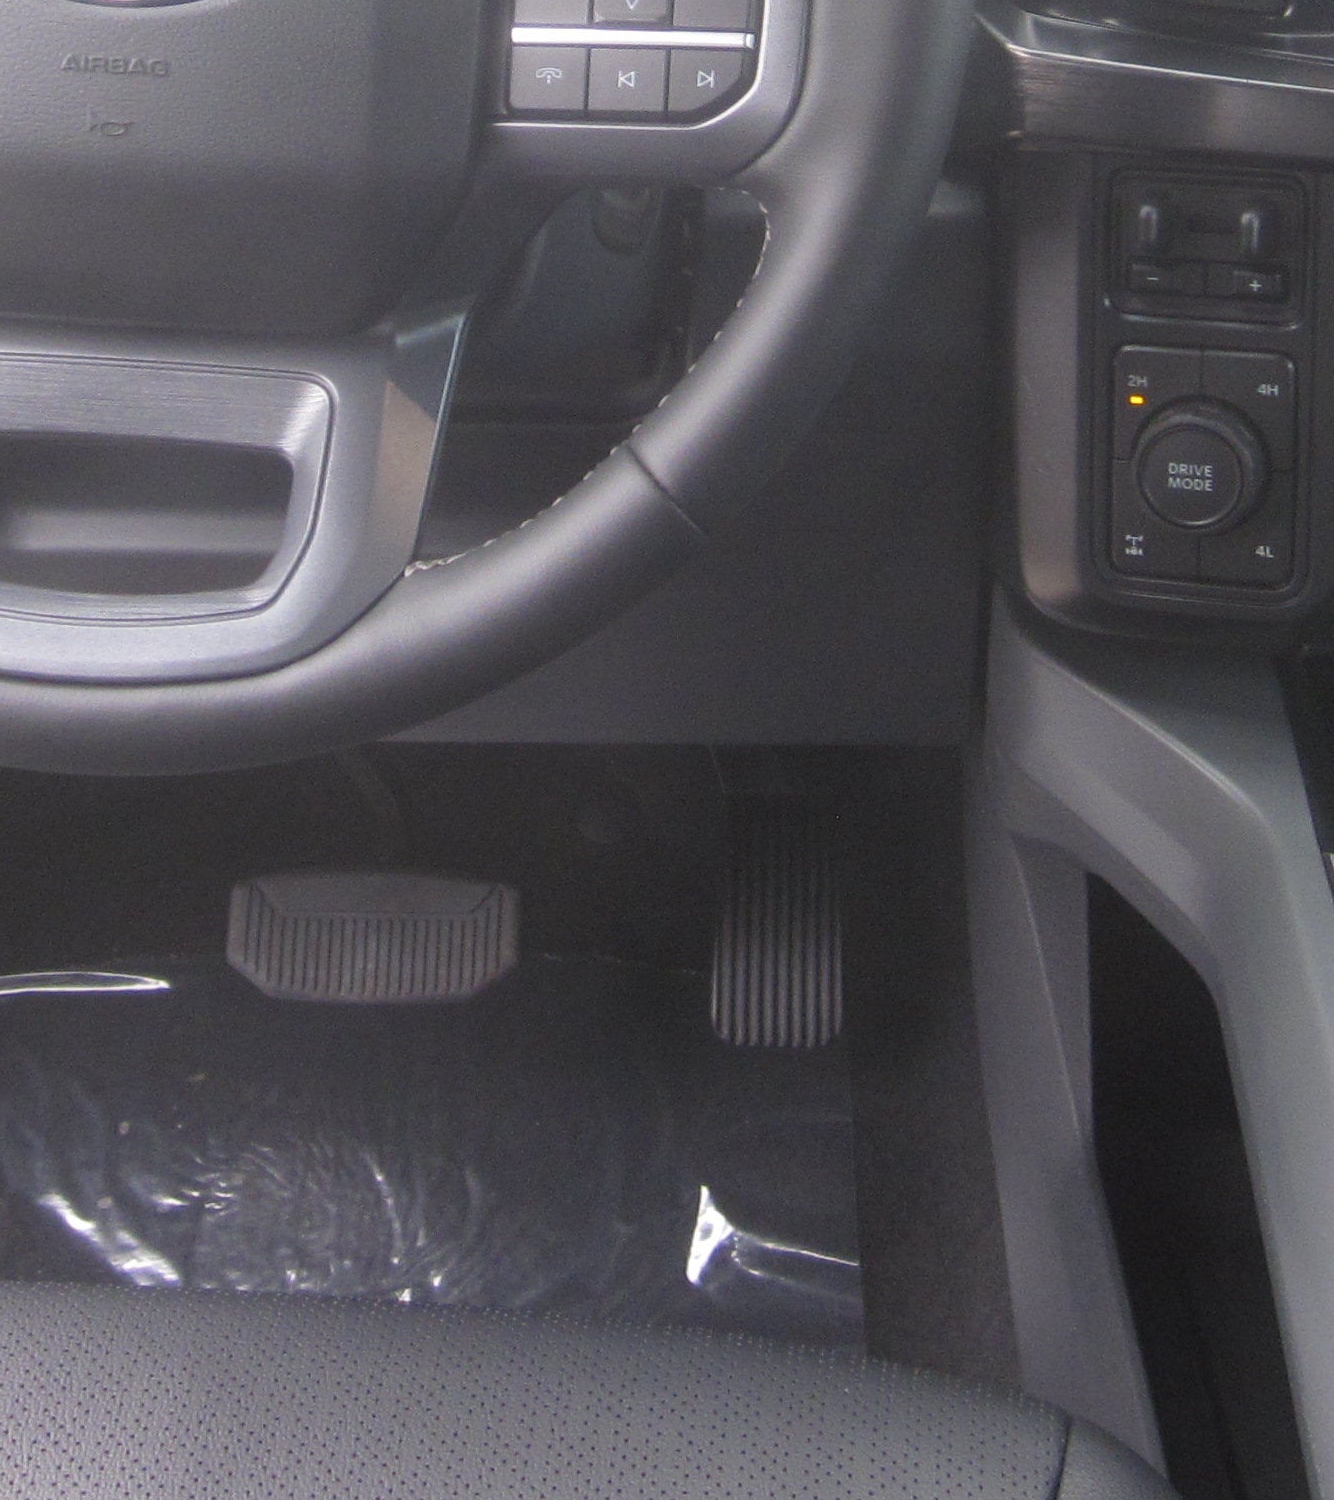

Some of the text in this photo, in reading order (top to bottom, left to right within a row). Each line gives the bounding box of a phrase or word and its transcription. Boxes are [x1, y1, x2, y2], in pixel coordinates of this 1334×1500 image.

[59, 52, 169, 78] AIRBAG
[1127, 374, 1148, 389] 2H
[1256, 382, 1279, 397] 4H
[1167, 462, 1213, 478] DRIVE
[1167, 476, 1213, 492] MODE
[1254, 545, 1274, 559] 4L
